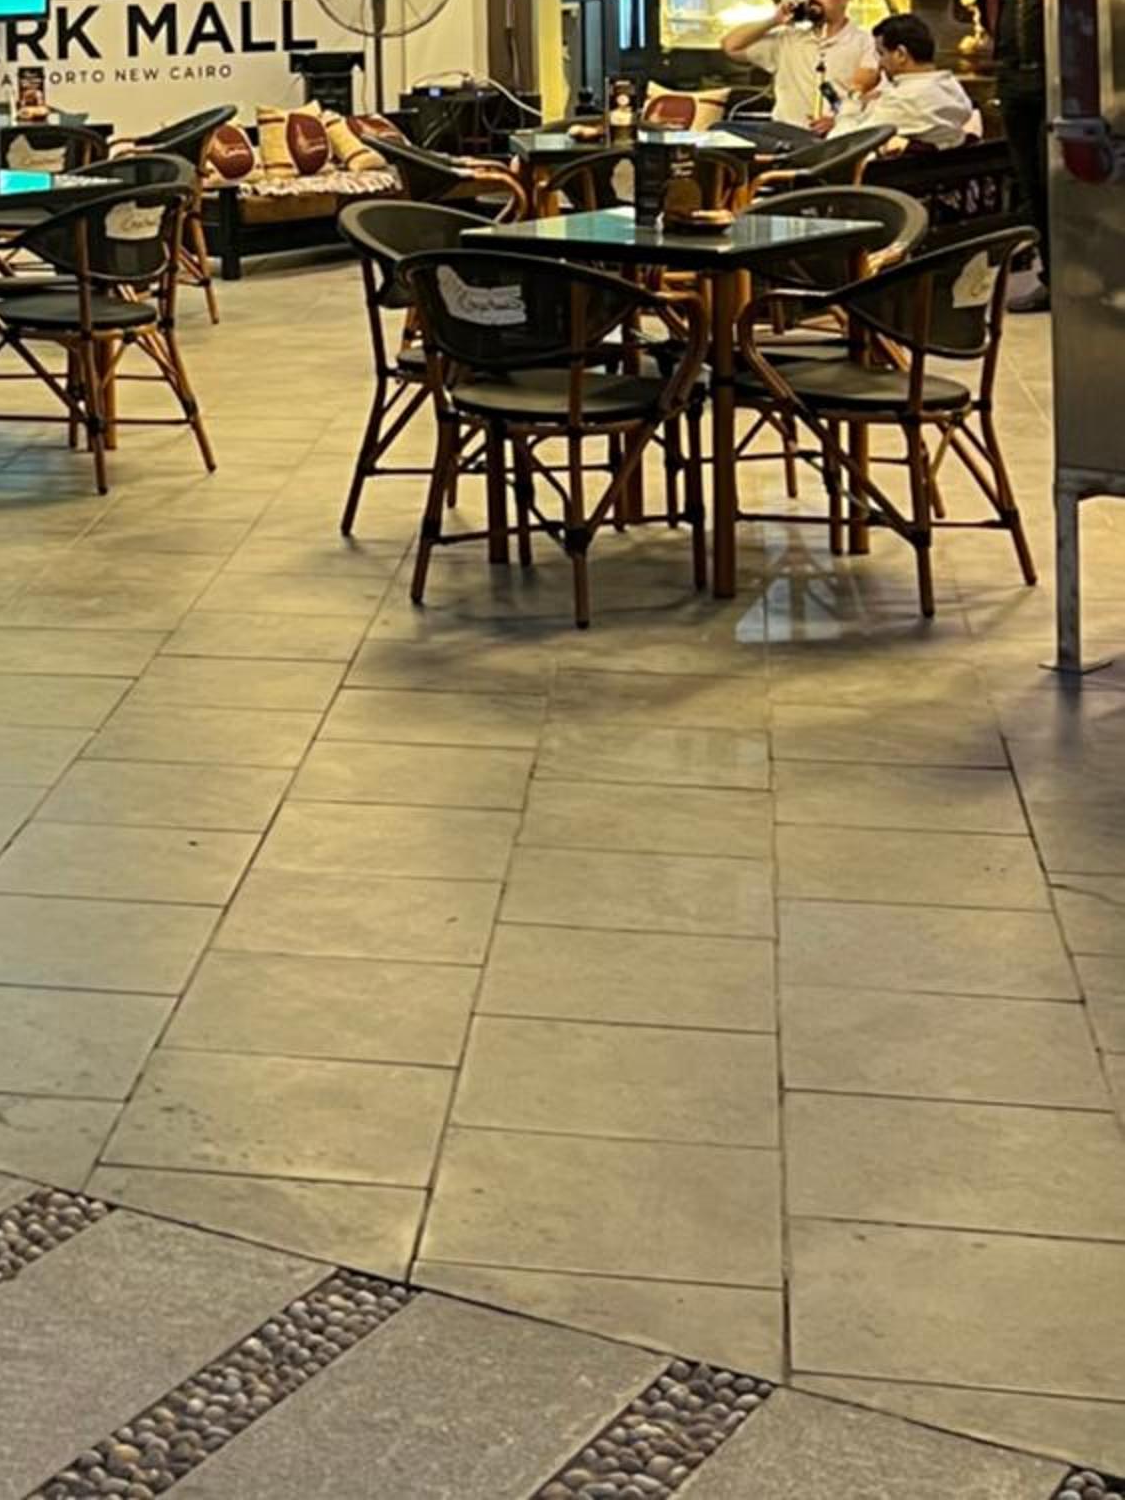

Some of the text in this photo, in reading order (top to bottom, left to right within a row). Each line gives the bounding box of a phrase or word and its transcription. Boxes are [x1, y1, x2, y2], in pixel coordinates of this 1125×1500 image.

[126, 0, 317, 58] MALL
[1, 65, 232, 87] A ORTO NEW CAIRO
